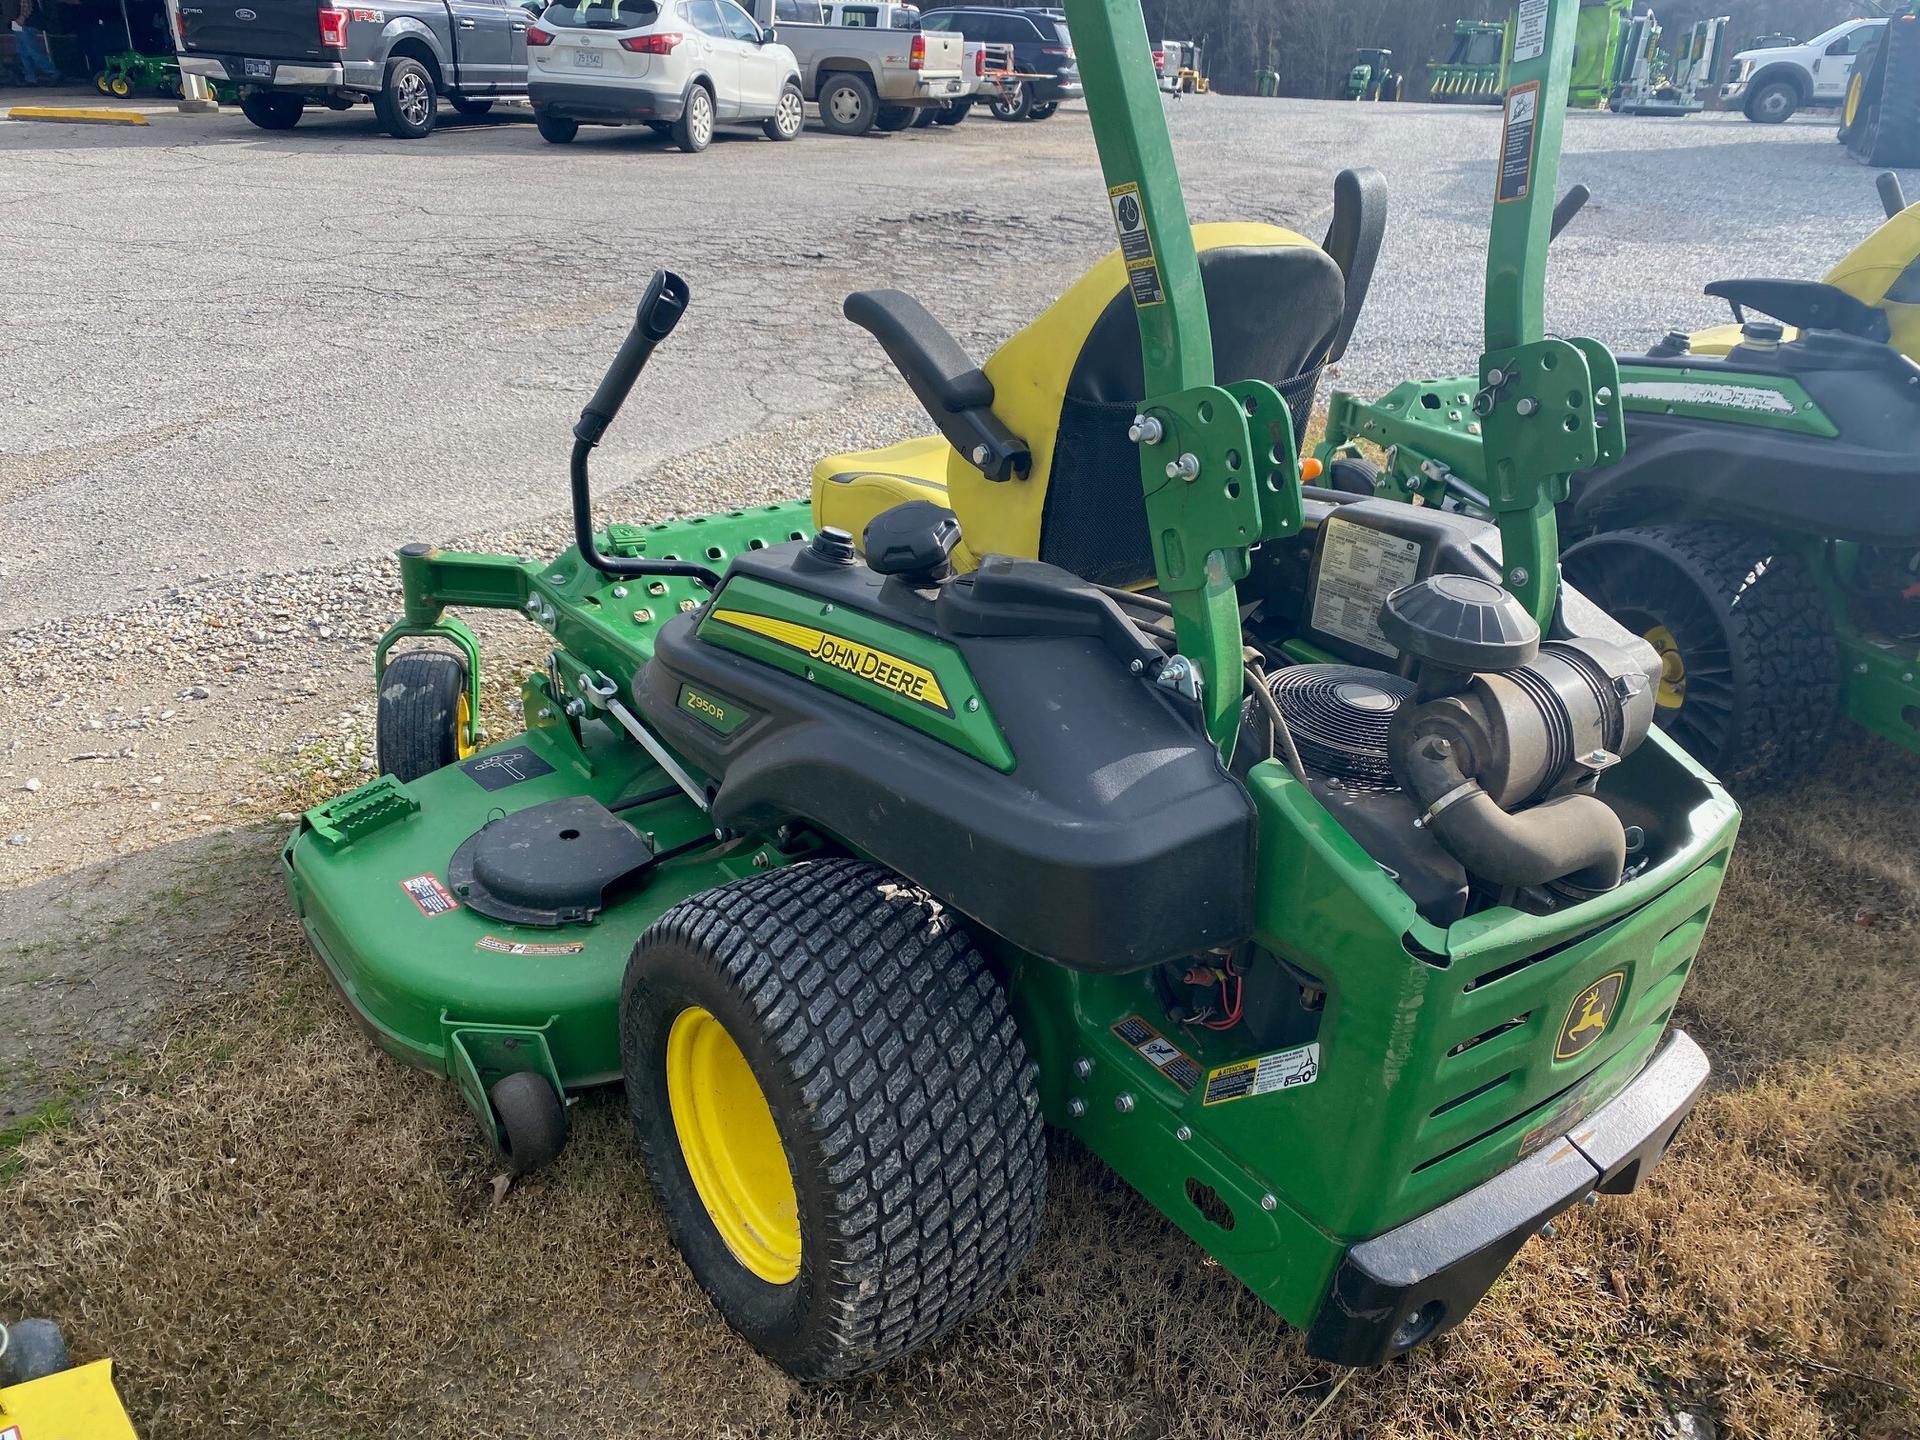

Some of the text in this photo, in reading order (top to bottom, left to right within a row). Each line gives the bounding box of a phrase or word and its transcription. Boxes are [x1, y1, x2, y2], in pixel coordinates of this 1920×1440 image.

[811, 635, 928, 697] JOHN DEERE
[687, 692, 724, 720] Z950R
